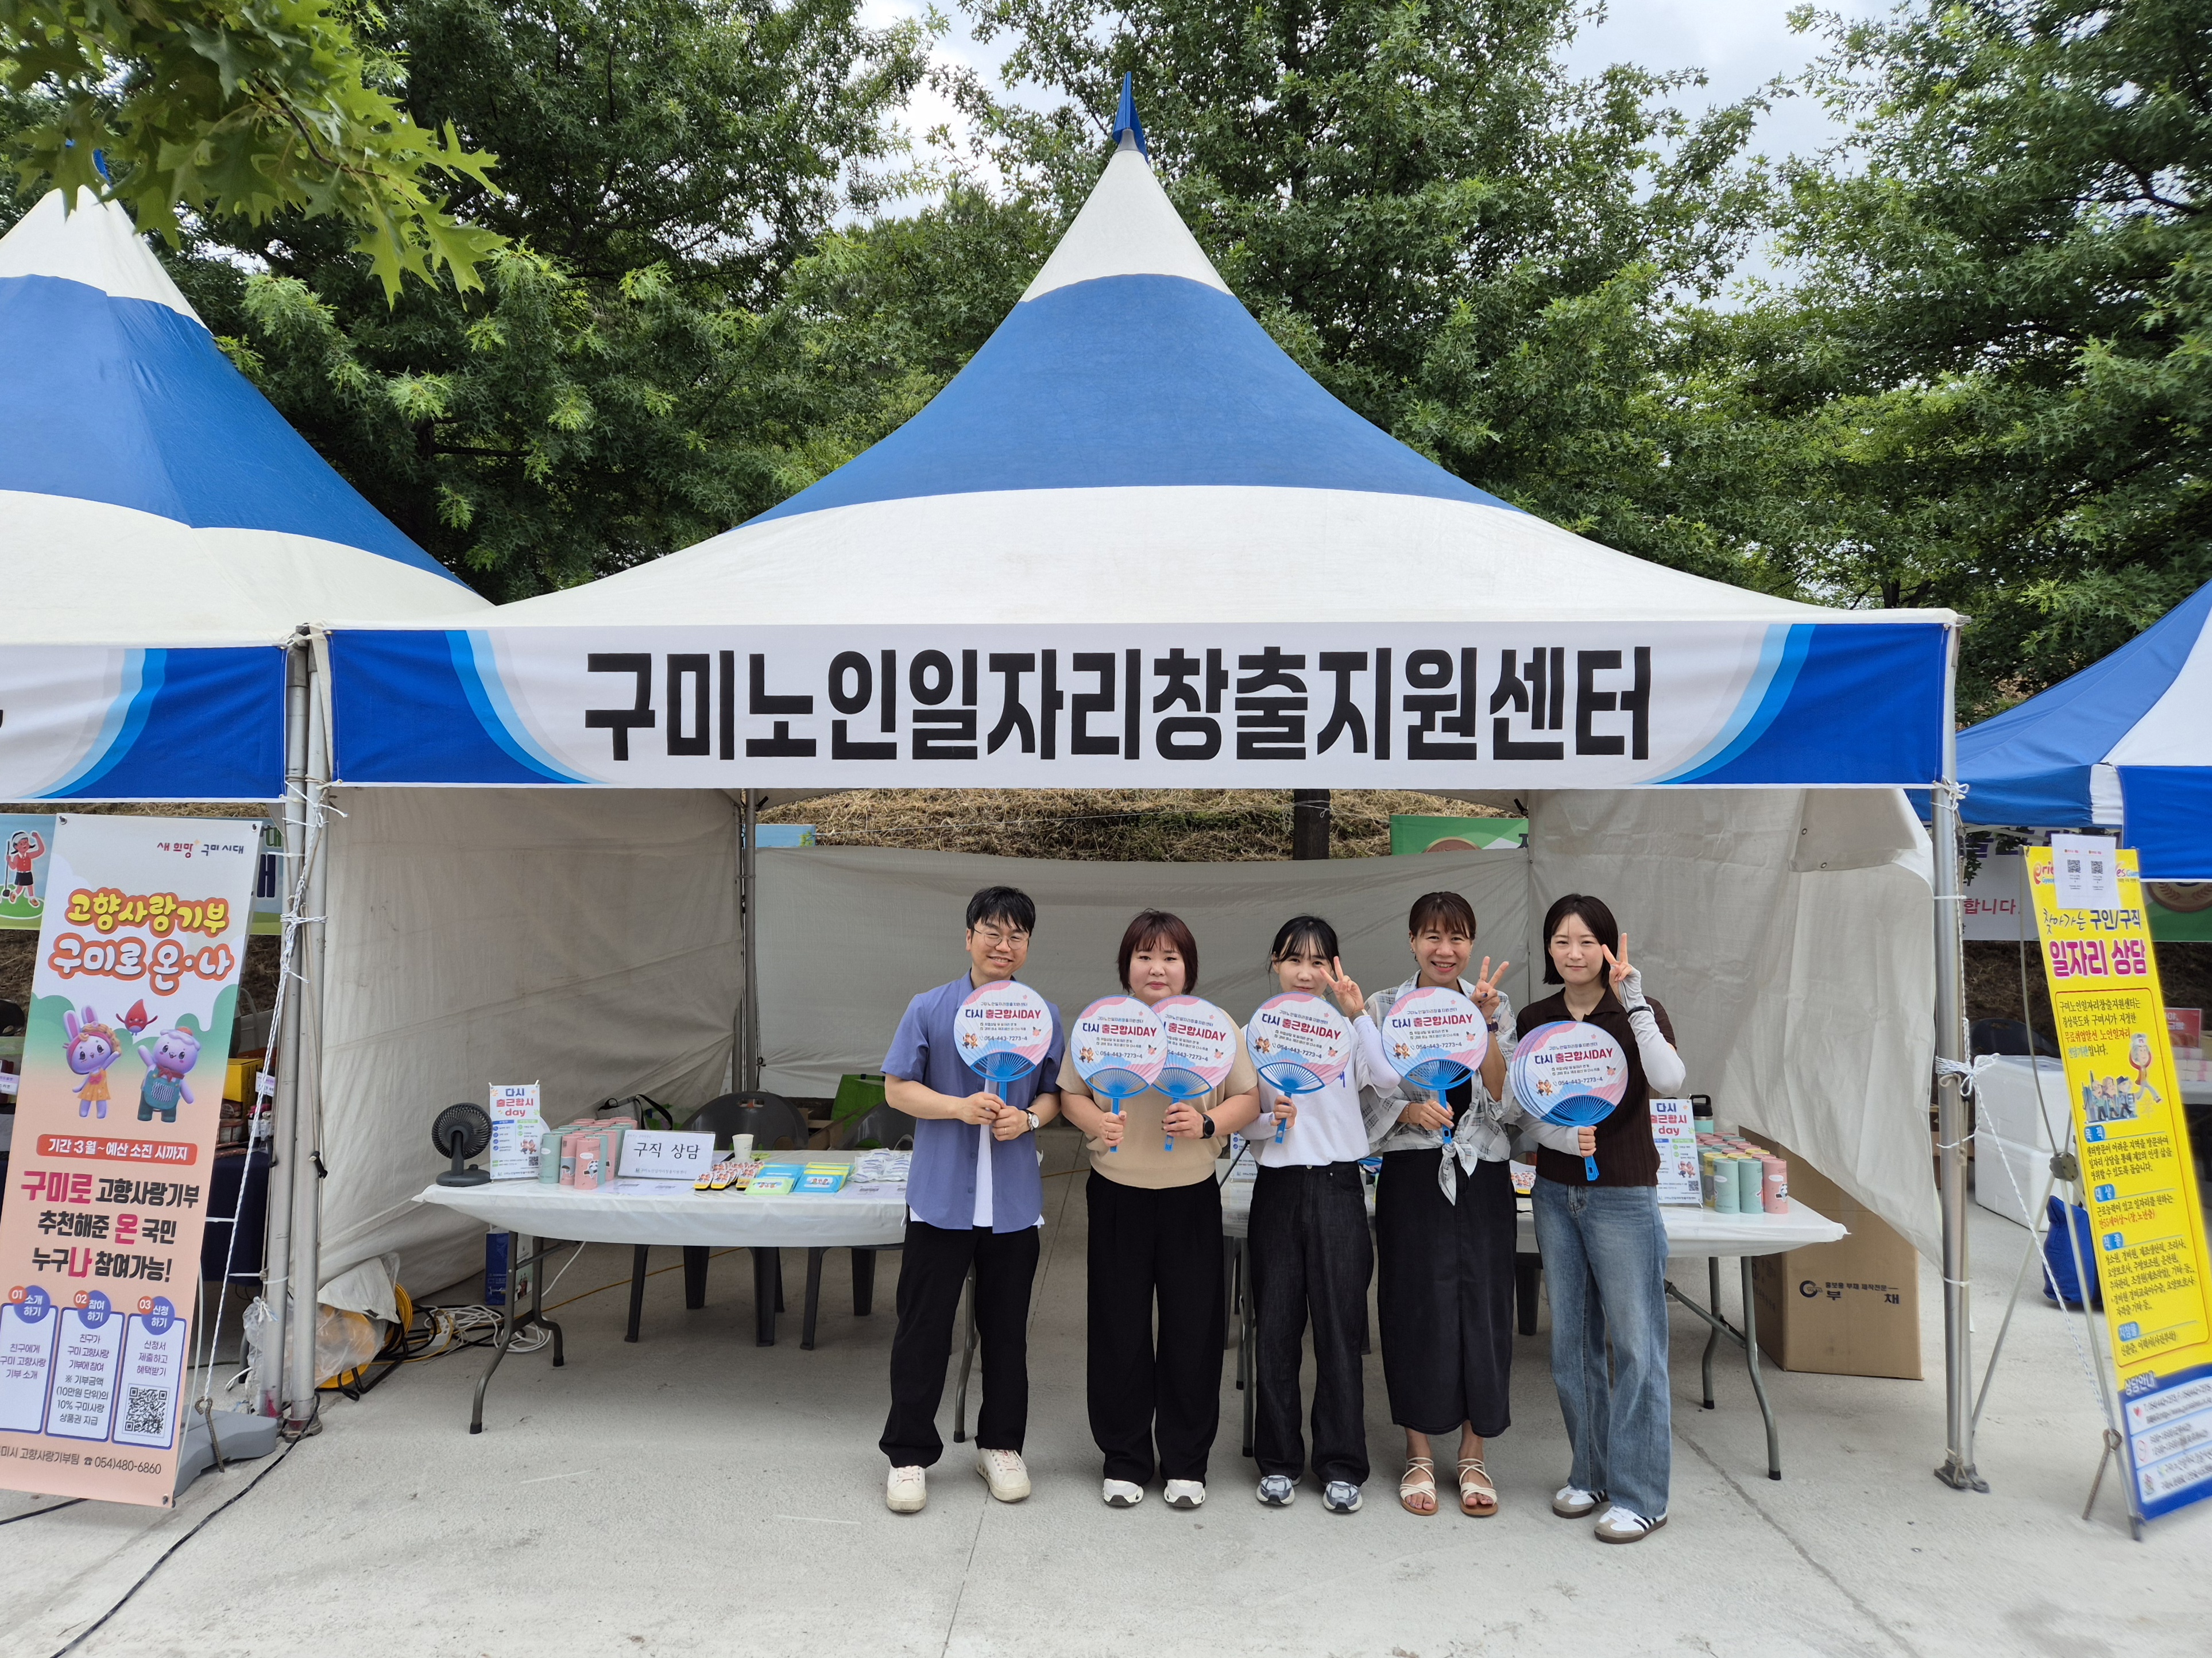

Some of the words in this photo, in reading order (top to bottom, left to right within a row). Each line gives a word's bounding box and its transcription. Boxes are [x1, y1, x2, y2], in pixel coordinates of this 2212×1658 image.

[585, 646, 1651, 761] 구미노인일자리창출지원센터
[157, 842, 170, 851] 새
[173, 842, 194, 858] 희망
[201, 844, 219, 856] 구미
[222, 845, 244, 854] 시대
[67, 893, 226, 933] 고향사랑기부
[2043, 908, 2086, 935] 찾아가는
[2090, 909, 2141, 930] 구인/구직
[53, 938, 142, 975] 구미로
[2049, 939, 2109, 977] 일자리
[2111, 939, 2147, 975] 상담
[2059, 997, 2141, 1013] 구미노인일자리창출지원센터는
[965, 1009, 983, 1018] 다시
[985, 1009, 1041, 1019] 출근합시DAY
[2062, 1014, 2089, 1028] 경상북도와
[2091, 1013, 2117, 1025] 구미시가
[2119, 1012, 2136, 1024] 지정한
[1262, 1013, 1280, 1026] 다시
[1282, 1018, 1341, 1040] 출근합시DAY
[1392, 1018, 1411, 1028] 다시
[1413, 1014, 1473, 1027] 출근합시DAY
[1082, 1022, 1099, 1033] 다시
[1102, 1024, 1157, 1037] 출근합시DAY
[1168, 1022, 1227, 1041] 출근합시DAY
[2064, 1029, 2098, 1043] 무료취업알선
[2099, 1026, 2130, 1040] 노인일자리
[1534, 1054, 1553, 1064] 다시
[1555, 1048, 1613, 1063] 출근합시DAY
[505, 1088, 525, 1097] 다시
[496, 1098, 534, 1107] 출근합시
[1656, 1103, 1677, 1113] 다시
[505, 1108, 526, 1117] day
[1658, 1126, 1680, 1136] day
[48, 1138, 72, 1153] 기간
[130, 1144, 153, 1159] 소진
[154, 1145, 188, 1160] 시까지
[633, 1142, 662, 1158] 구직
[671, 1144, 701, 1160] 상담
[2087, 1143, 2112, 1157] 센터방문이
[2112, 1141, 2128, 1153] 어려운
[2129, 1139, 2145, 1150] 지역을
[2146, 1135, 2169, 1148] 방문하여
[2089, 1157, 2103, 1169] 일자리
[2104, 1155, 2120, 1166] 상담을
[2106, 1168, 2112, 1179] 수
[2112, 1164, 2128, 1177] 있도록
[21, 1171, 92, 1204] 구미로
[95, 1178, 200, 1208] 고향사랑기부
[2097, 1202, 2121, 1217] 근로능력이
[2122, 1200, 2133, 1212] 있고
[2134, 1198, 2155, 1209] 일자리를
[2156, 1194, 2173, 1205] 원하는
[38, 1210, 110, 1239] 추천해준
[115, 1214, 138, 1245] 온
[142, 1218, 177, 1245] 국민
[32, 1246, 92, 1278] 누구나
[95, 1251, 172, 1283] 참여가능!
[11, 1289, 23, 1300] 01
[25, 1295, 42, 1306] 소개
[75, 1294, 87, 1304] 02
[1827, 1291, 1842, 1301] 부
[1884, 1293, 1900, 1304] 채
[88, 1299, 105, 1310] 참여
[139, 1299, 151, 1310] 03
[153, 1305, 169, 1316] 신청
[24, 1306, 41, 1317] 하기
[87, 1311, 103, 1322] 하기
[151, 1317, 168, 1328] 하기
[80, 1334, 100, 1344] 친구가
[144, 1340, 166, 1350] 신청서
[10, 1343, 40, 1353] 친구에게
[67, 1346, 81, 1356] 구미
[82, 1347, 110, 1358] 고향사랑
[0, 1356, 15, 1365] 구미
[17, 1357, 47, 1367] 고향사랑
[138, 1352, 168, 1364] 제출하고
[68, 1360, 89, 1370] 기부에
[90, 1361, 105, 1372] 참여
[137, 1365, 167, 1377] 혜택받기
[6, 1369, 21, 1378] 기부
[22, 1370, 38, 1380] 소개
[74, 1375, 103, 1386] 기부금액
[2125, 1370, 2156, 1396] 상담안내
[56, 1386, 83, 1398] (10만원
[84, 1388, 109, 1400] 단위)의
[57, 1399, 73, 1410] 10%
[75, 1401, 105, 1413] 구미사랑
[59, 1413, 82, 1424] 상품권
[83, 1415, 98, 1426] 지급
[0, 1445, 18, 1458] 미시
[19, 1448, 80, 1465] 고향사랑기부팀
[95, 1456, 162, 1475] 054)480-6860
